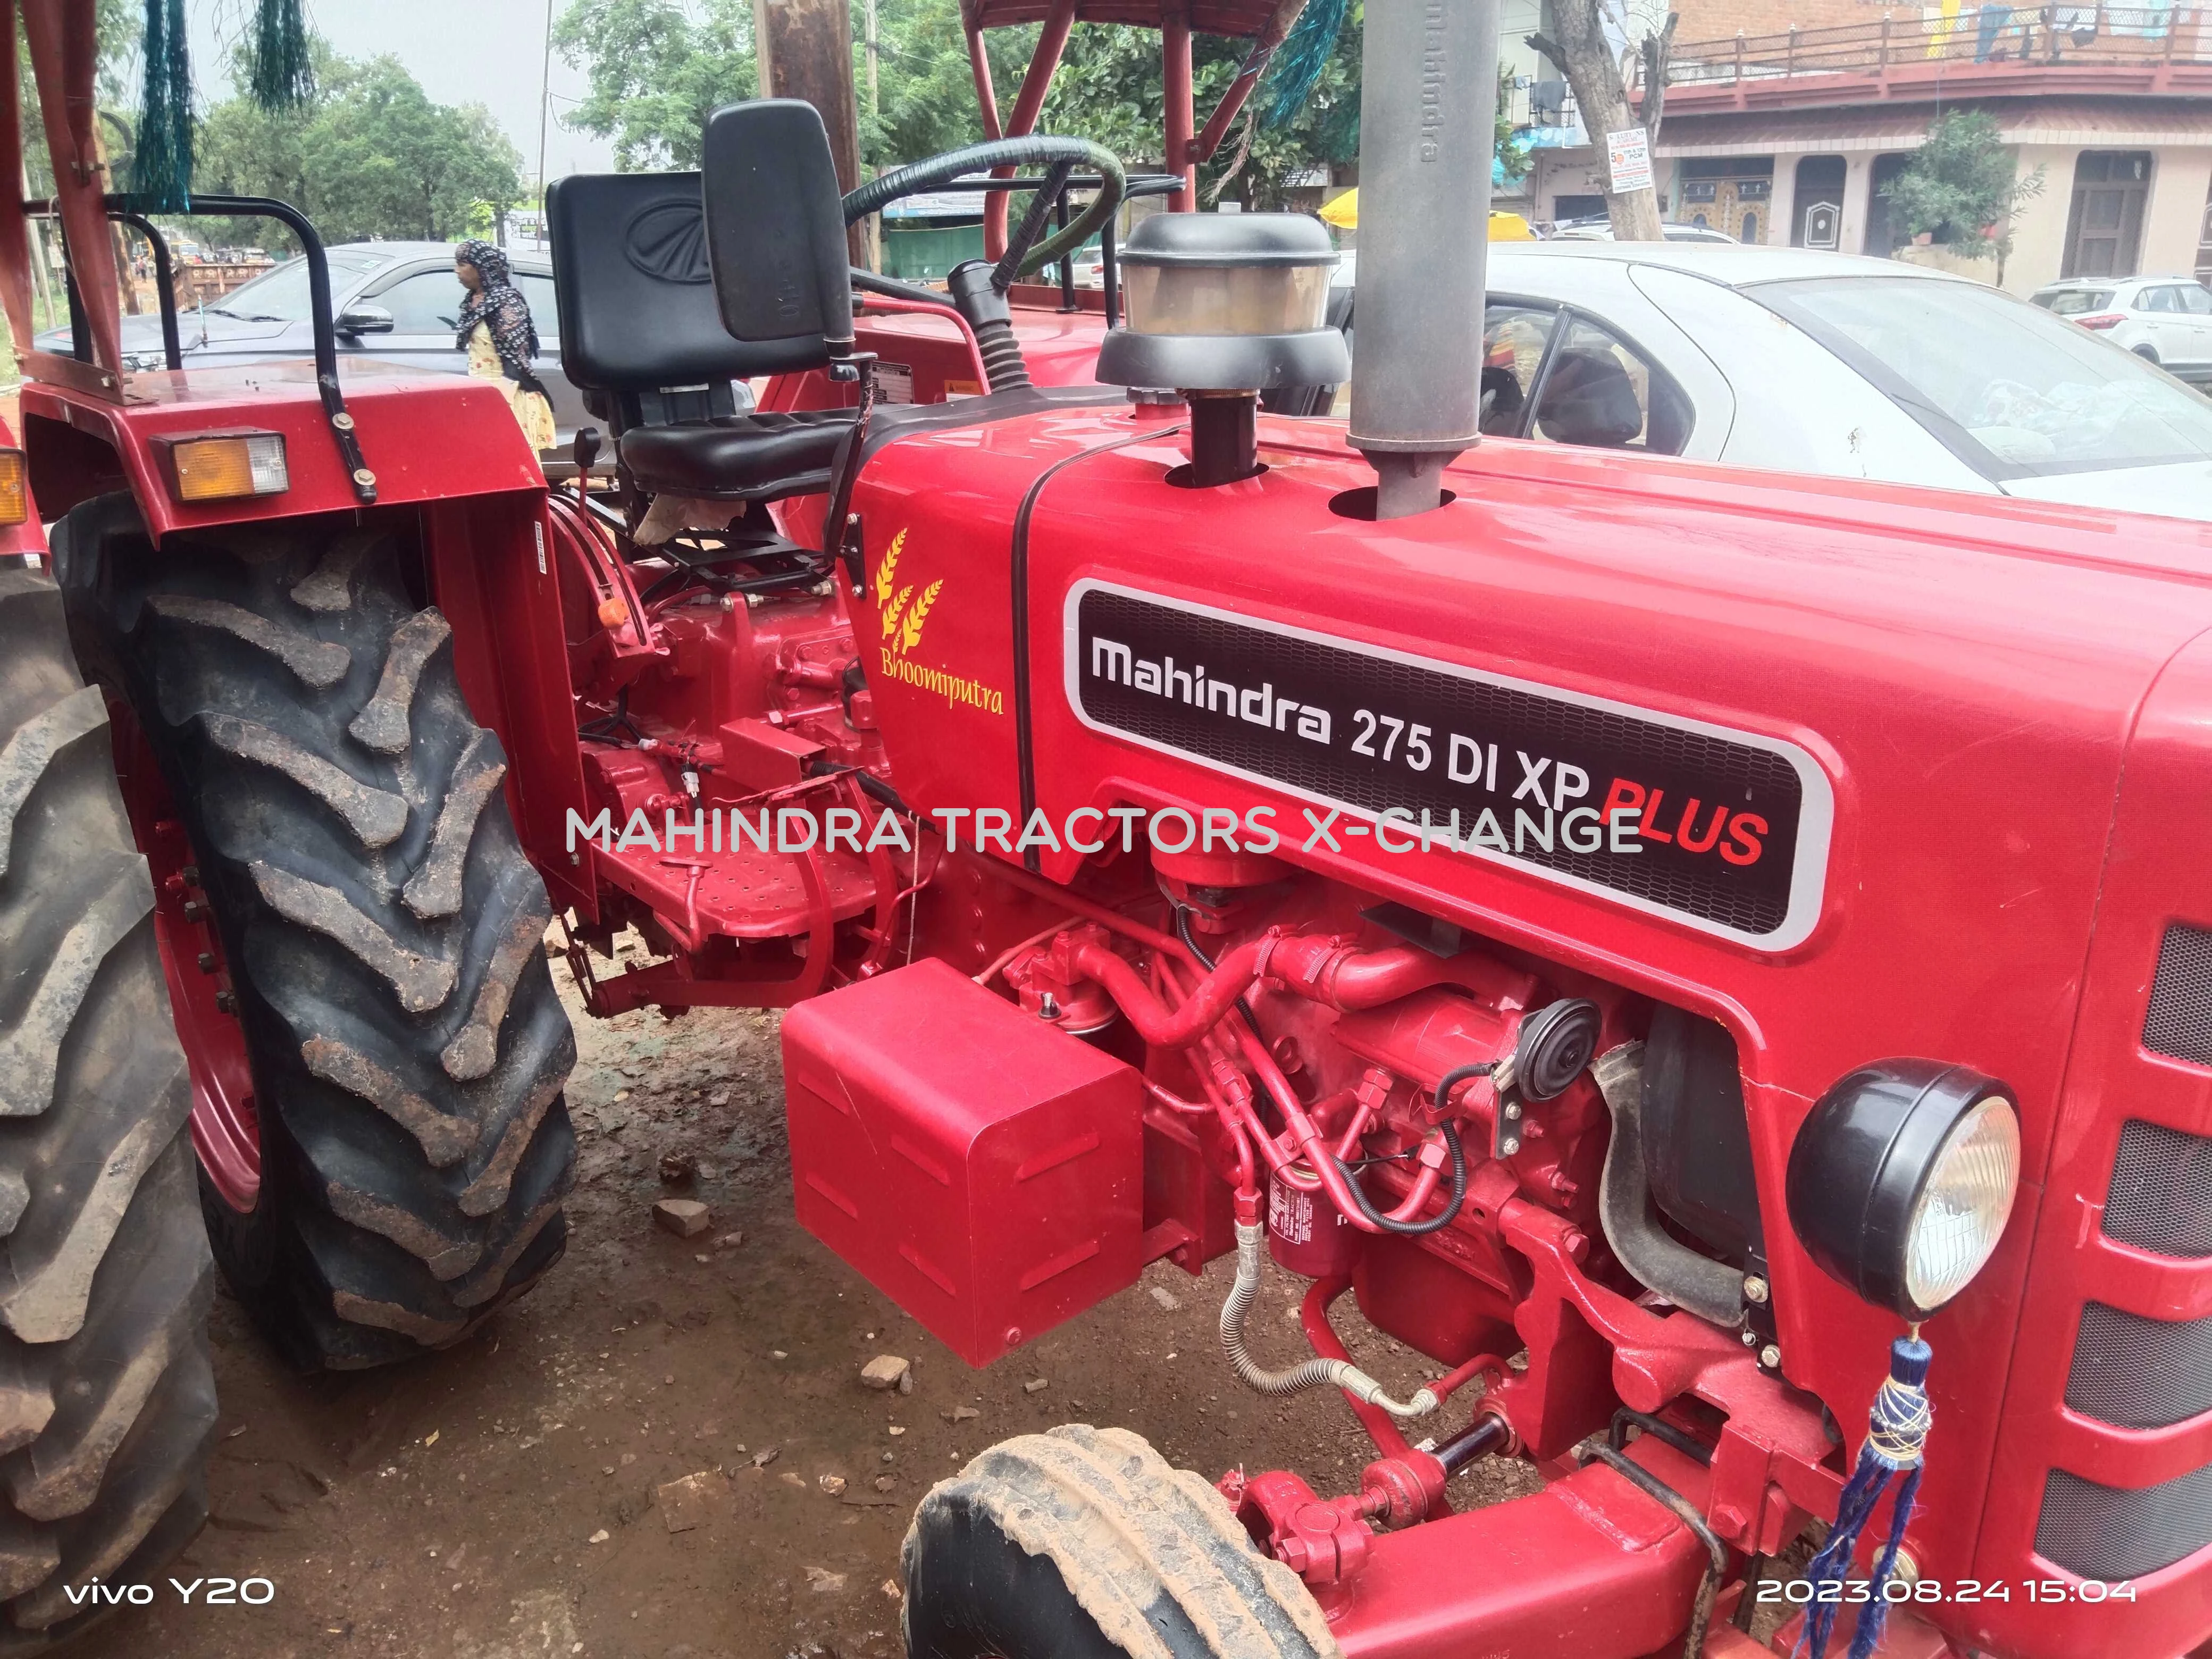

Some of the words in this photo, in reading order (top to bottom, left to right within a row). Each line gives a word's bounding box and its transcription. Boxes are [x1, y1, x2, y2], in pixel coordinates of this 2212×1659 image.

[879, 647, 1004, 715] Bhoomiputra
[1093, 636, 1331, 744] mahindra
[1351, 709, 1432, 771] 275
[1448, 733, 1498, 792] DI
[1512, 750, 1590, 812] XP
[1598, 777, 1769, 866] PLUS
